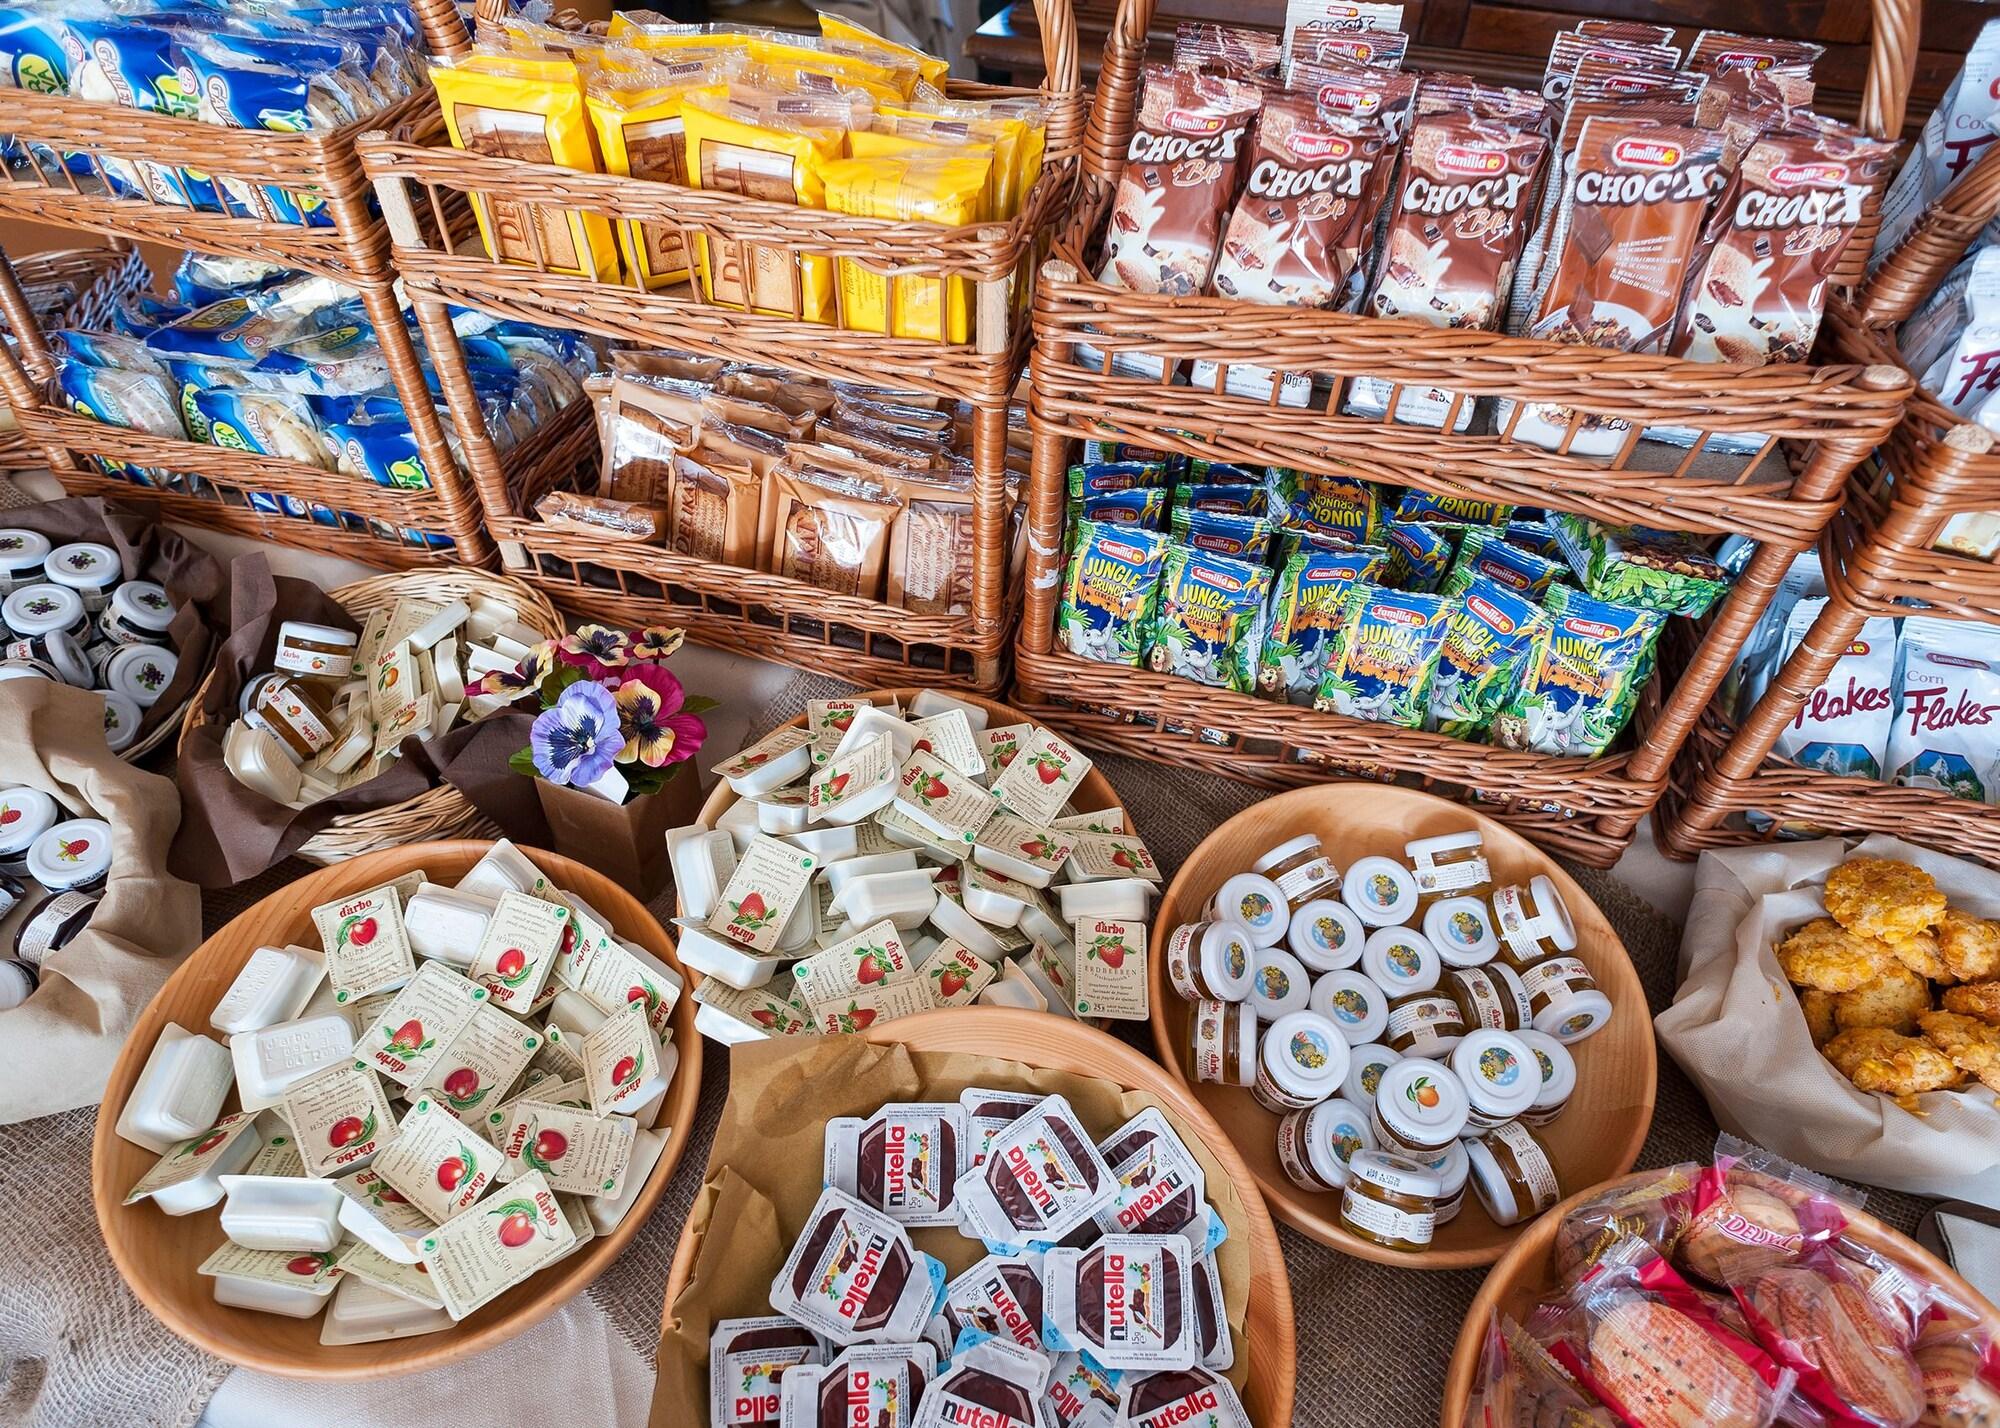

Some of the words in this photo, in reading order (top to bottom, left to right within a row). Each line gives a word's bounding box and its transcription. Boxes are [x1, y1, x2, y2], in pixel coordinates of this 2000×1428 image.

[1171, 112, 1207, 130] familia
[1128, 128, 1245, 162] CHOC'X
[1292, 138, 1333, 155] familia
[1622, 144, 1665, 162] familia
[1441, 150, 1487, 168] familia
[1249, 160, 1373, 197] CHOC'X
[1576, 164, 1717, 203] CHOC'X
[1403, 173, 1530, 214] CHOC'X
[1095, 478, 1125, 487] familia
[1307, 500, 1366, 528] JUNGLE
[1103, 541, 1134, 559] familia
[1198, 536, 1230, 550] familia
[1084, 557, 1143, 592] JUNGLE
[1196, 568, 1229, 586] familia
[1311, 568, 1342, 579] familia
[1485, 562, 1517, 584] familia
[1090, 577, 1127, 599] CRUNCH
[1178, 583, 1237, 612] JUNGLE
[1185, 605, 1223, 624] CRUNCH
[1377, 607, 1412, 623] familia
[1471, 598, 1503, 626] familia
[1359, 623, 1424, 658] JUNGLE
[1453, 612, 1502, 658] UNGLE
[1569, 620, 1606, 636] familia
[1366, 644, 1409, 667] CRUNCH
[1906, 671, 1944, 685] Corn
[1903, 687, 2000, 737] Flakes
[887, 1126, 906, 1207] nutella
[1007, 1147, 1060, 1219] nutella
[1116, 1171, 1184, 1231] nutella
[839, 1233, 888, 1320] nutella
[1104, 1254, 1125, 1342] nutella
